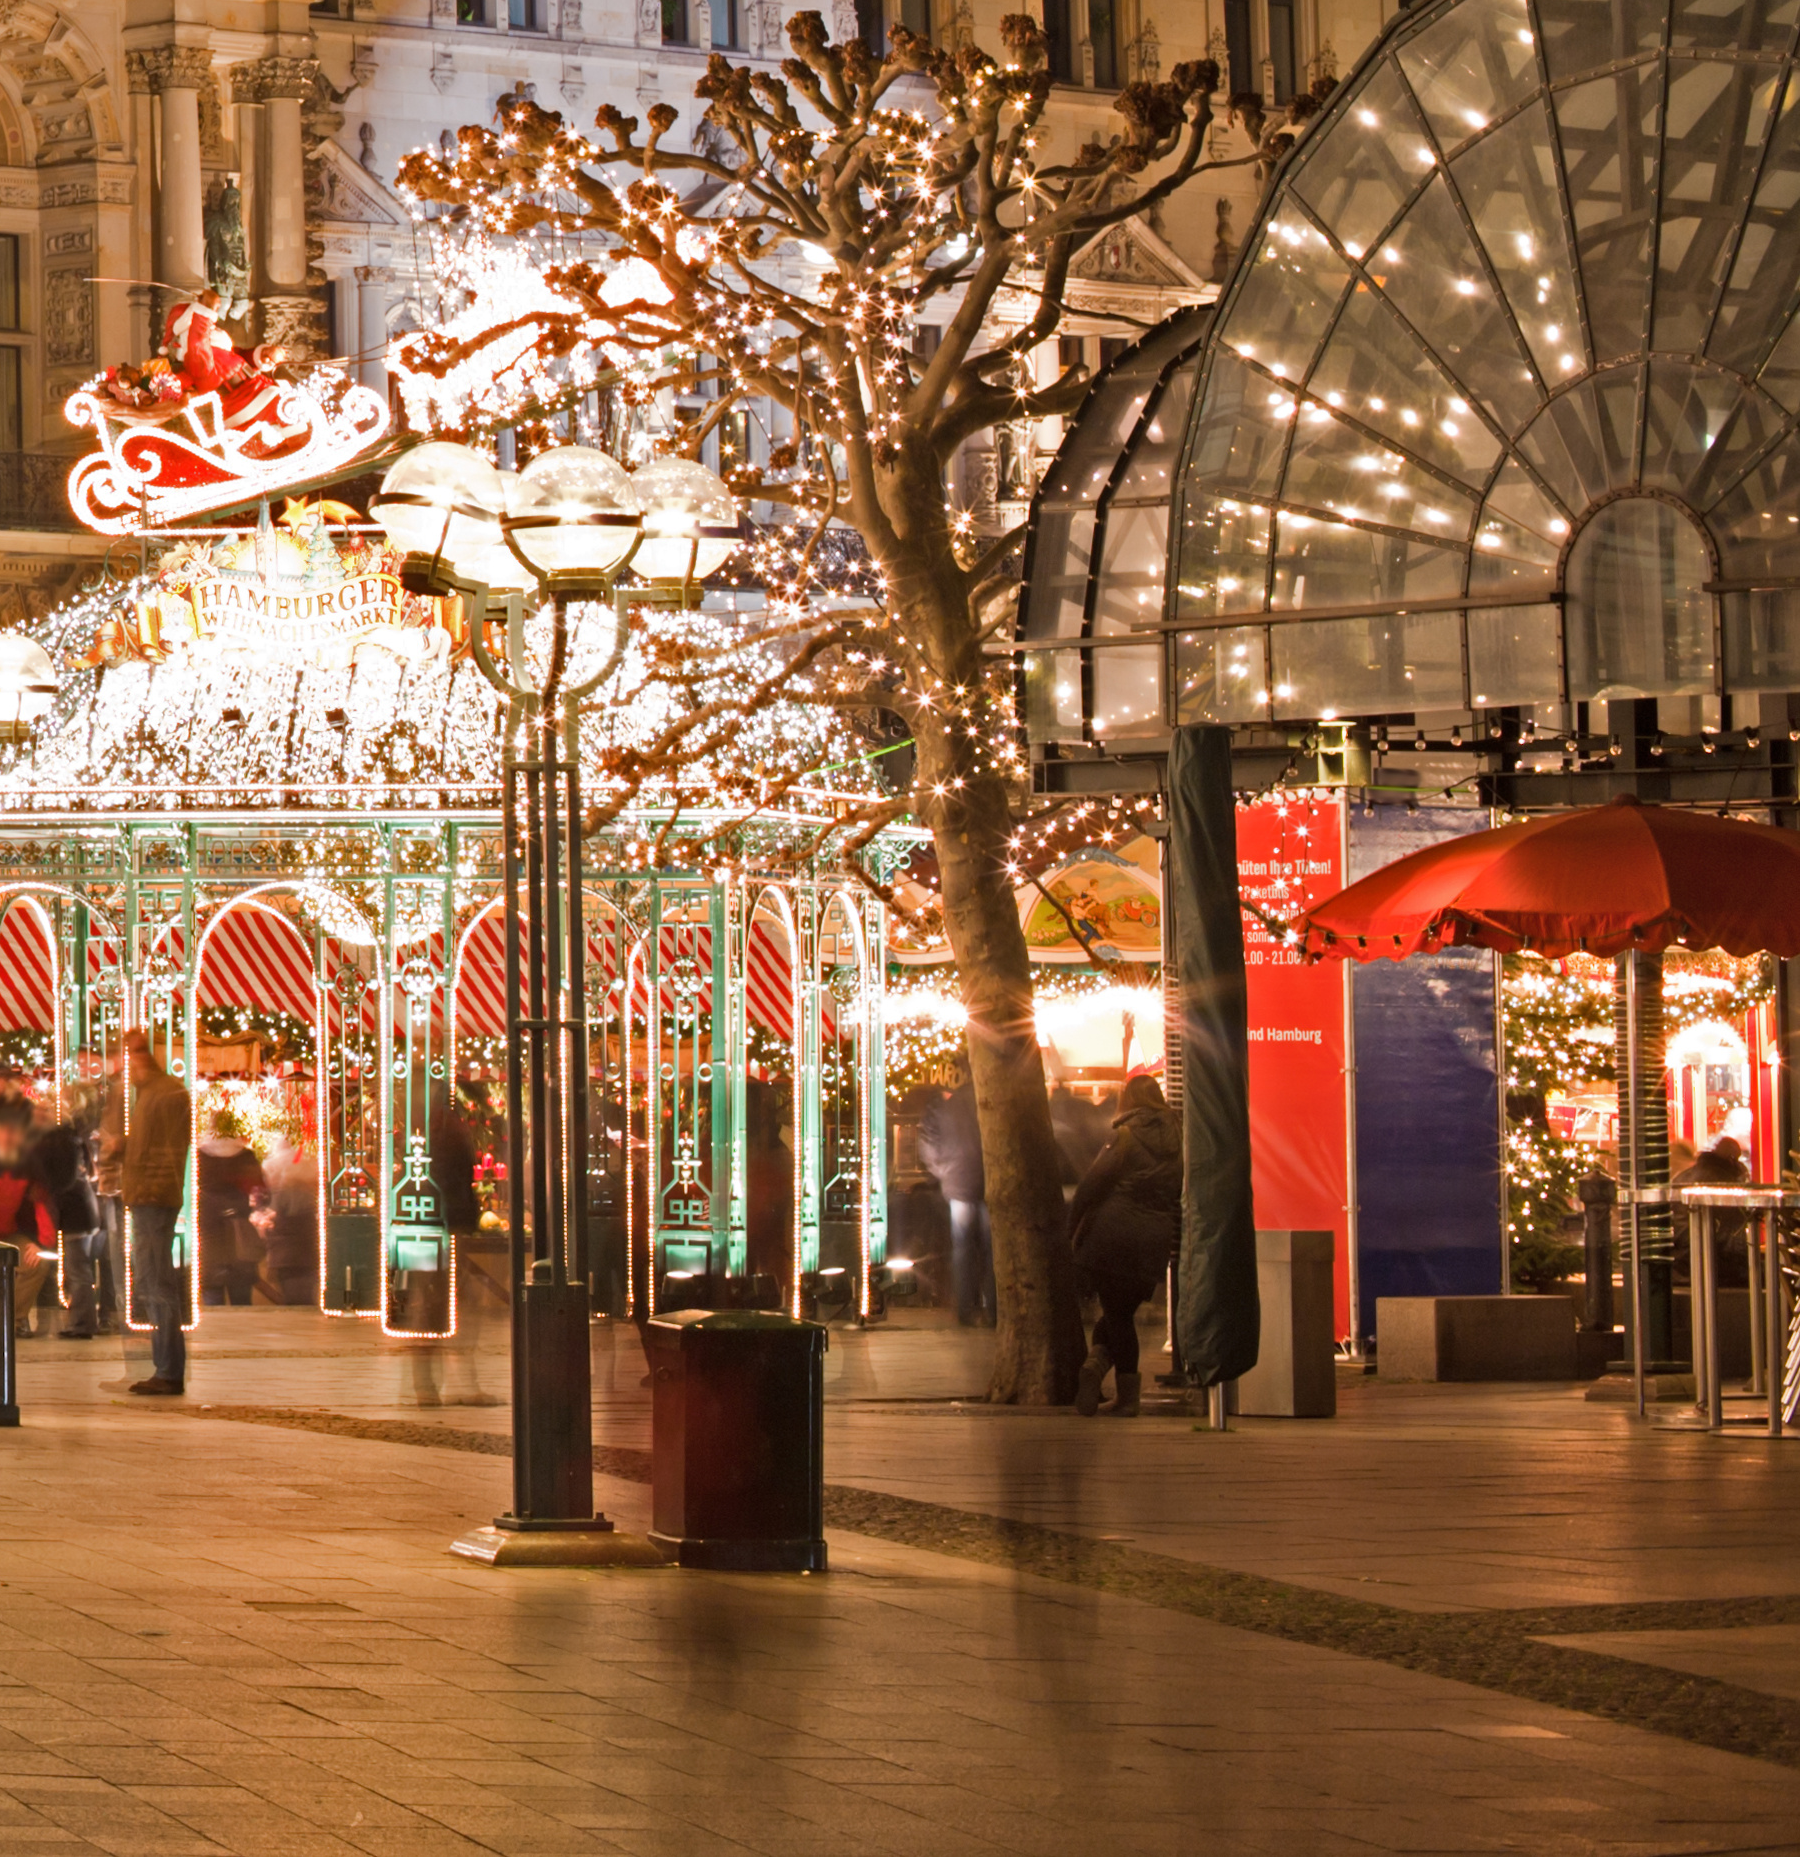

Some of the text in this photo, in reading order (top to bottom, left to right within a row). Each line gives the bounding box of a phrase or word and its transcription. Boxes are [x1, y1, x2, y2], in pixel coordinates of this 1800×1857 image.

[200, 578, 398, 620] HAMBURGER
[202, 607, 398, 643] WEIHNACHTSMARKT
[1267, 1027, 1322, 1045] Hamburg
